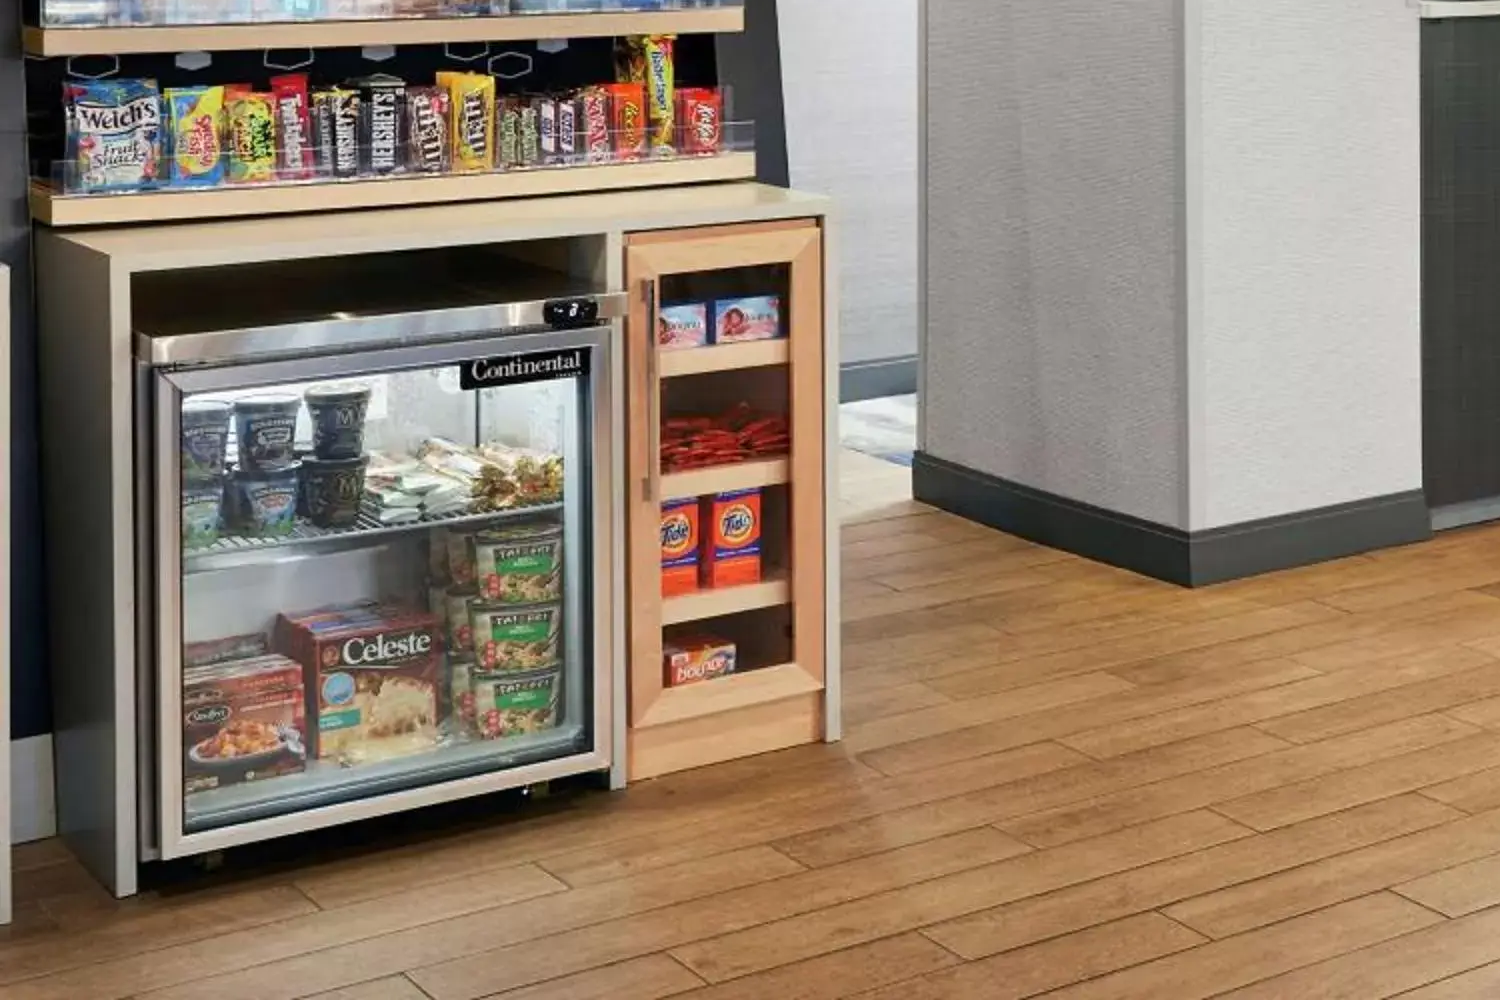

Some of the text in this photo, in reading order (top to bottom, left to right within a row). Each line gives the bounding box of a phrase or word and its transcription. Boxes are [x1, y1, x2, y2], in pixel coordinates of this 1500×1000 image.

[79, 102, 157, 130] Welch's
[372, 93, 395, 169] HERSHEY'S
[471, 351, 581, 381] Continental
[343, 632, 431, 665] Celeste
